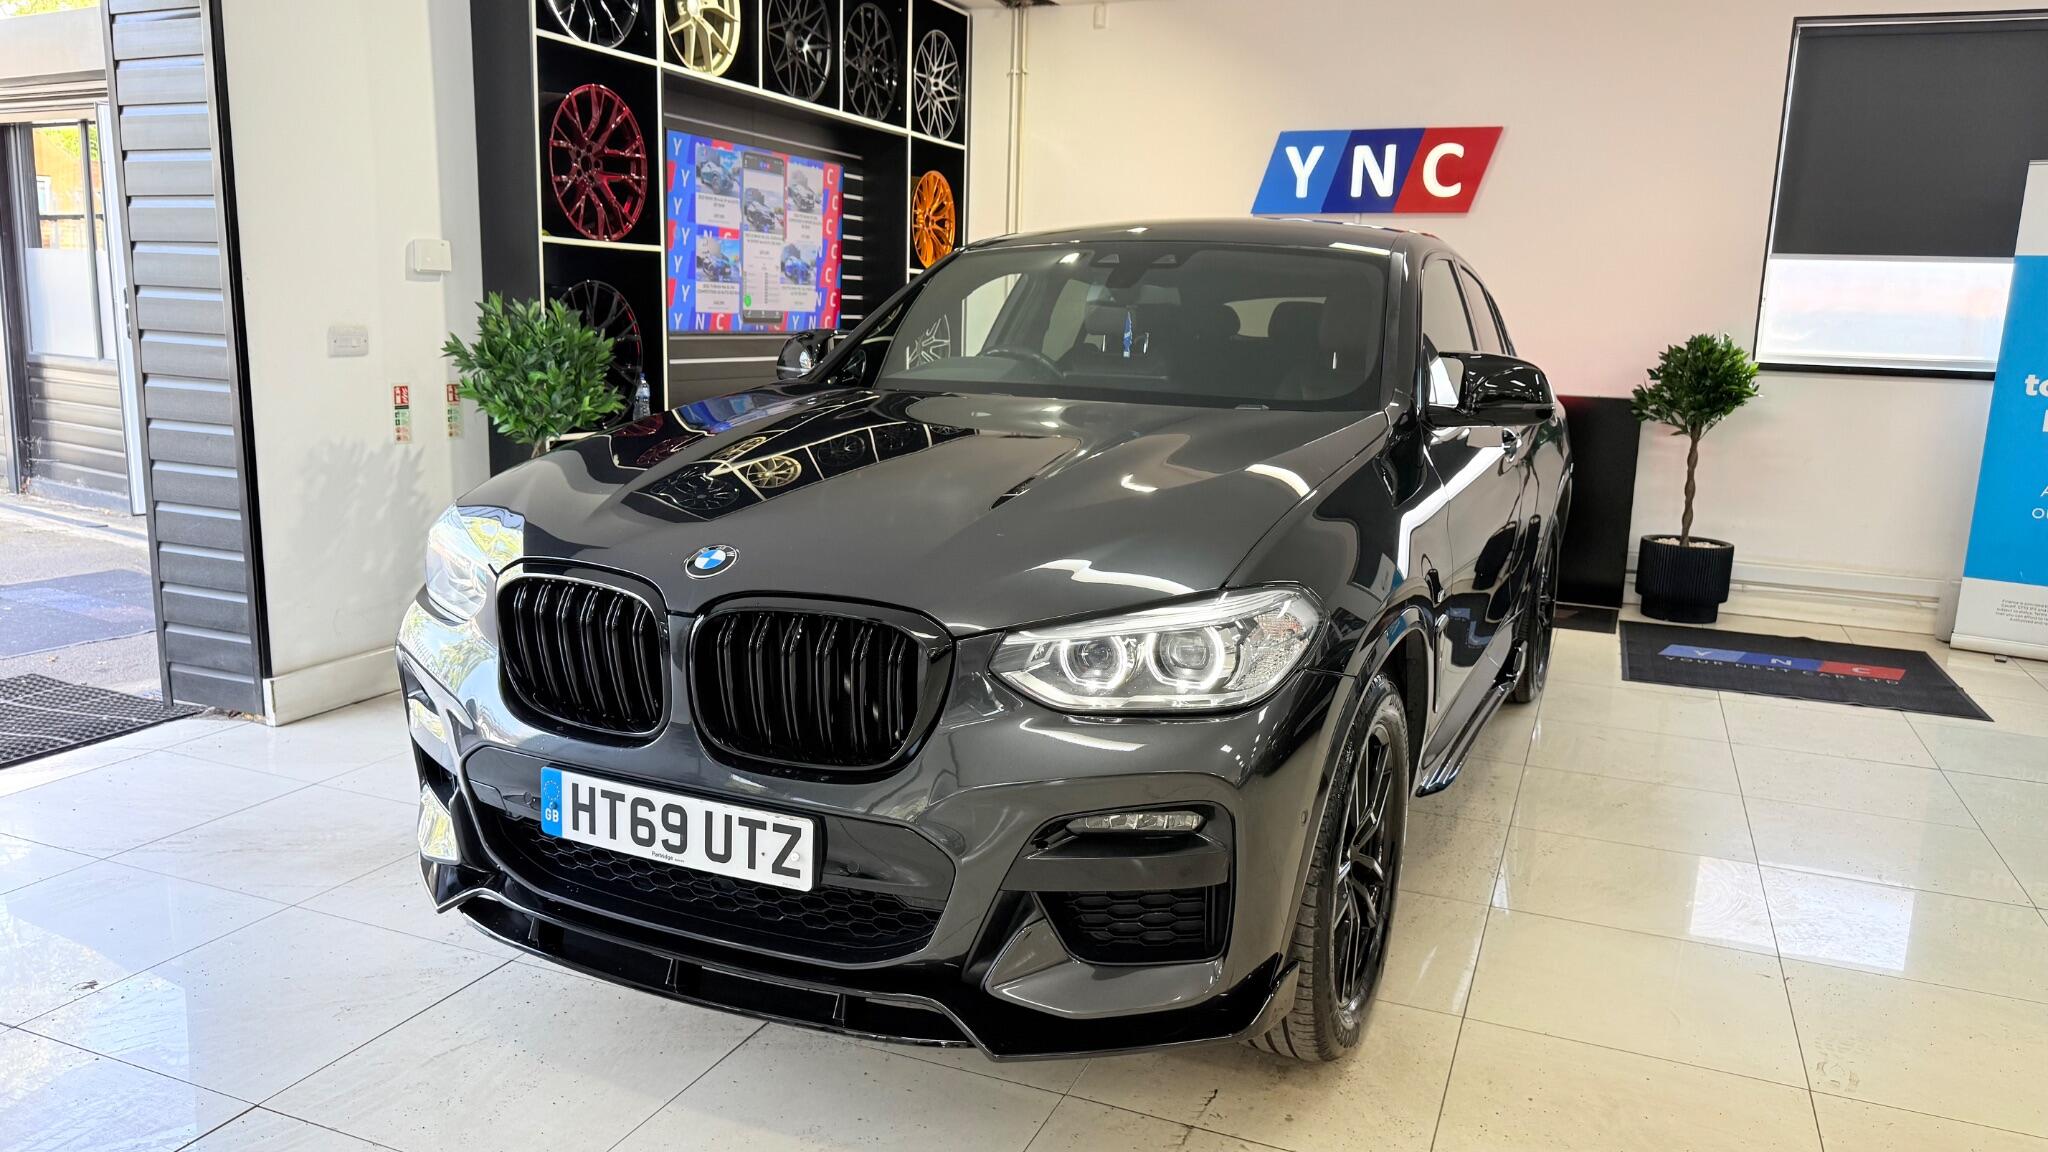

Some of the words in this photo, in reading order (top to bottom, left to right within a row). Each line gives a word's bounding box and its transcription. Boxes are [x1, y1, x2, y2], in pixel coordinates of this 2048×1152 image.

[1285, 142, 1465, 199] YNC
[545, 808, 559, 823] GB
[571, 782, 688, 854] HT69
[704, 811, 802, 879] UTZ
